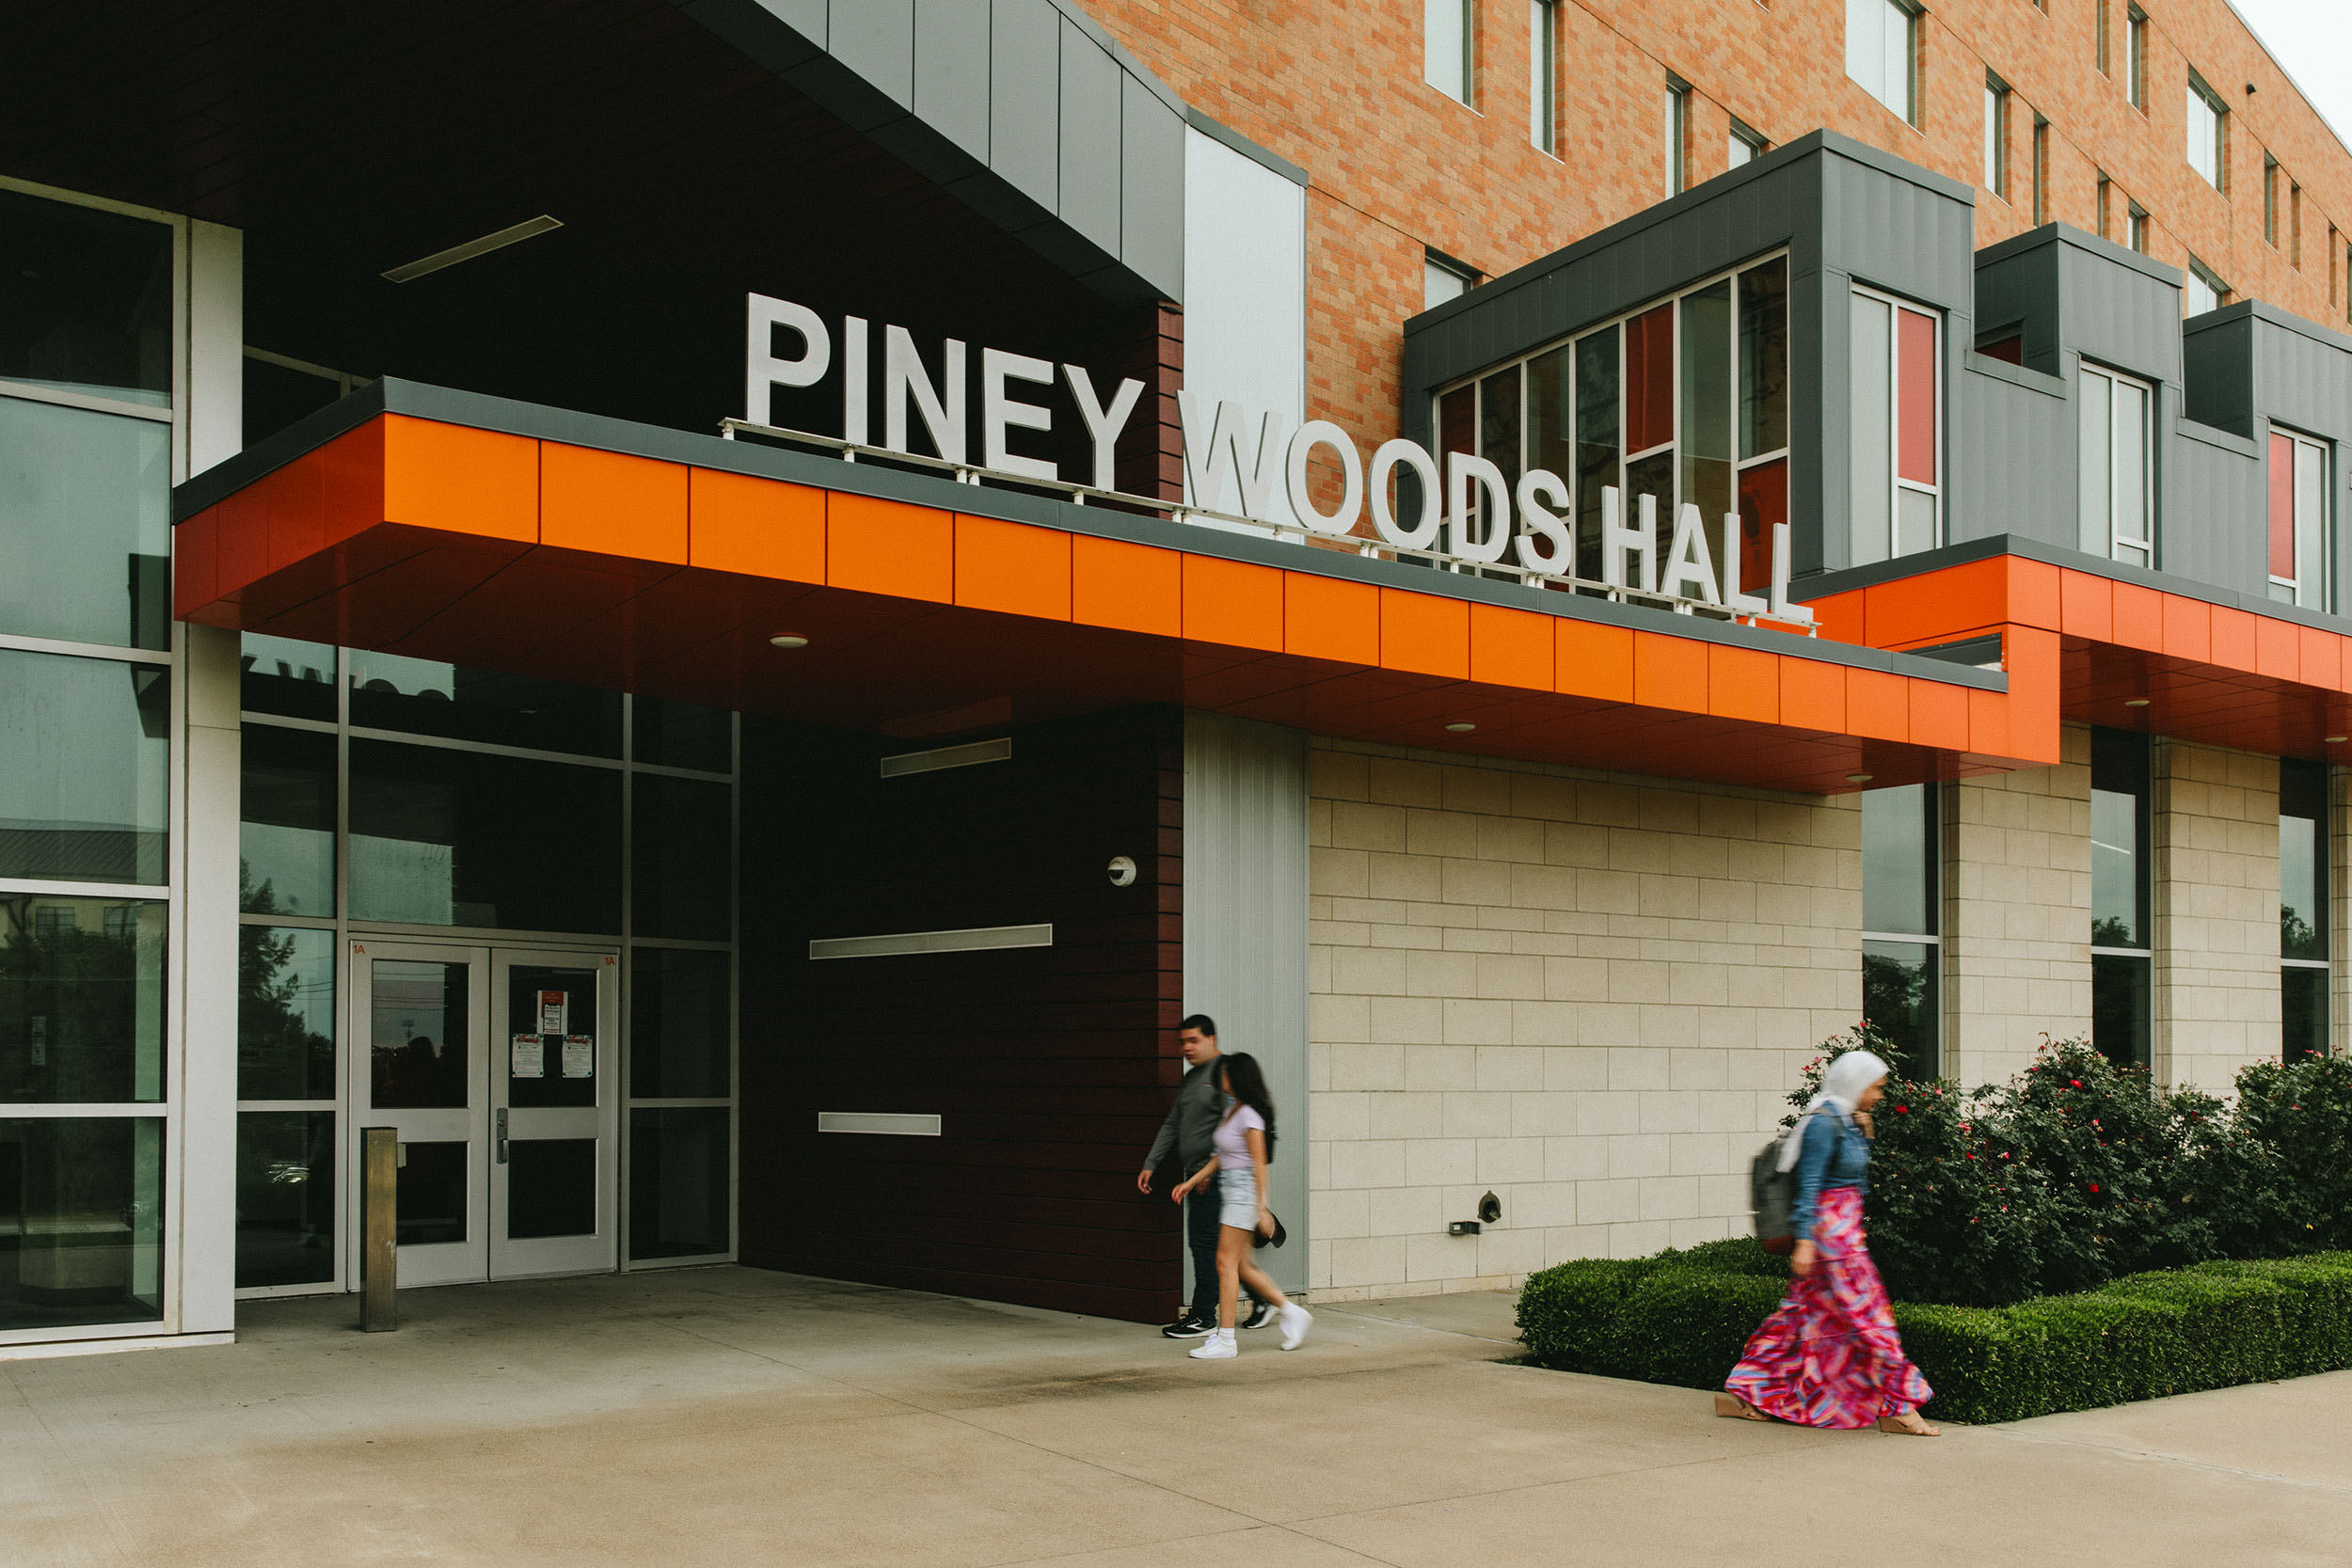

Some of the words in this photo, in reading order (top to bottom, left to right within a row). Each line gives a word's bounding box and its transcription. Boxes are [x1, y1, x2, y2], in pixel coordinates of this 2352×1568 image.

[746, 292, 1146, 492] PINEY
[1176, 389, 1571, 576] WOODS
[1601, 485, 1814, 623] HALL
[354, 944, 366, 955] 1A
[605, 956, 616, 965] 1A
